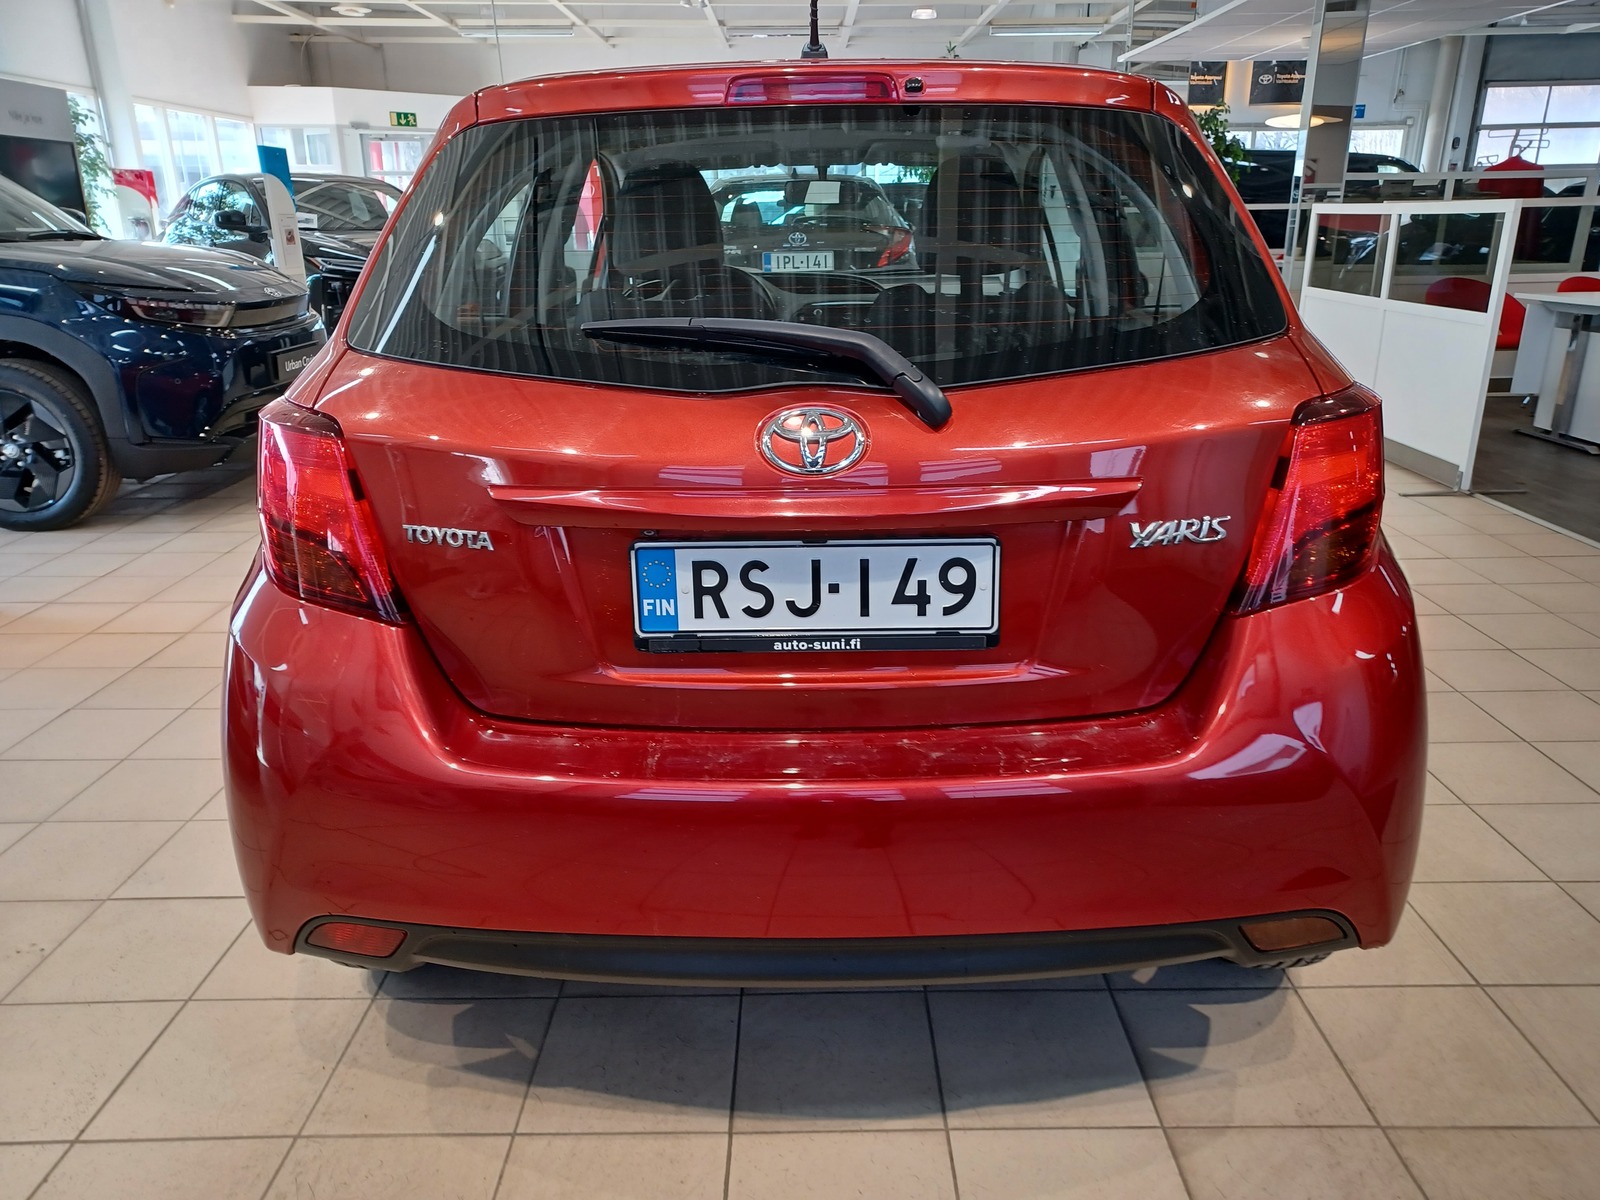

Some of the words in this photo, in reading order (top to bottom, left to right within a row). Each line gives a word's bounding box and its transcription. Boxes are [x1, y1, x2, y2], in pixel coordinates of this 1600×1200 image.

[285, 359, 302, 372] Urban
[402, 524, 495, 551] TOYOTA
[1129, 515, 1232, 548] YARIS
[691, 557, 977, 619] RSJ-149
[643, 598, 675, 616] FIN
[773, 638, 861, 650] auto-suni.fi
